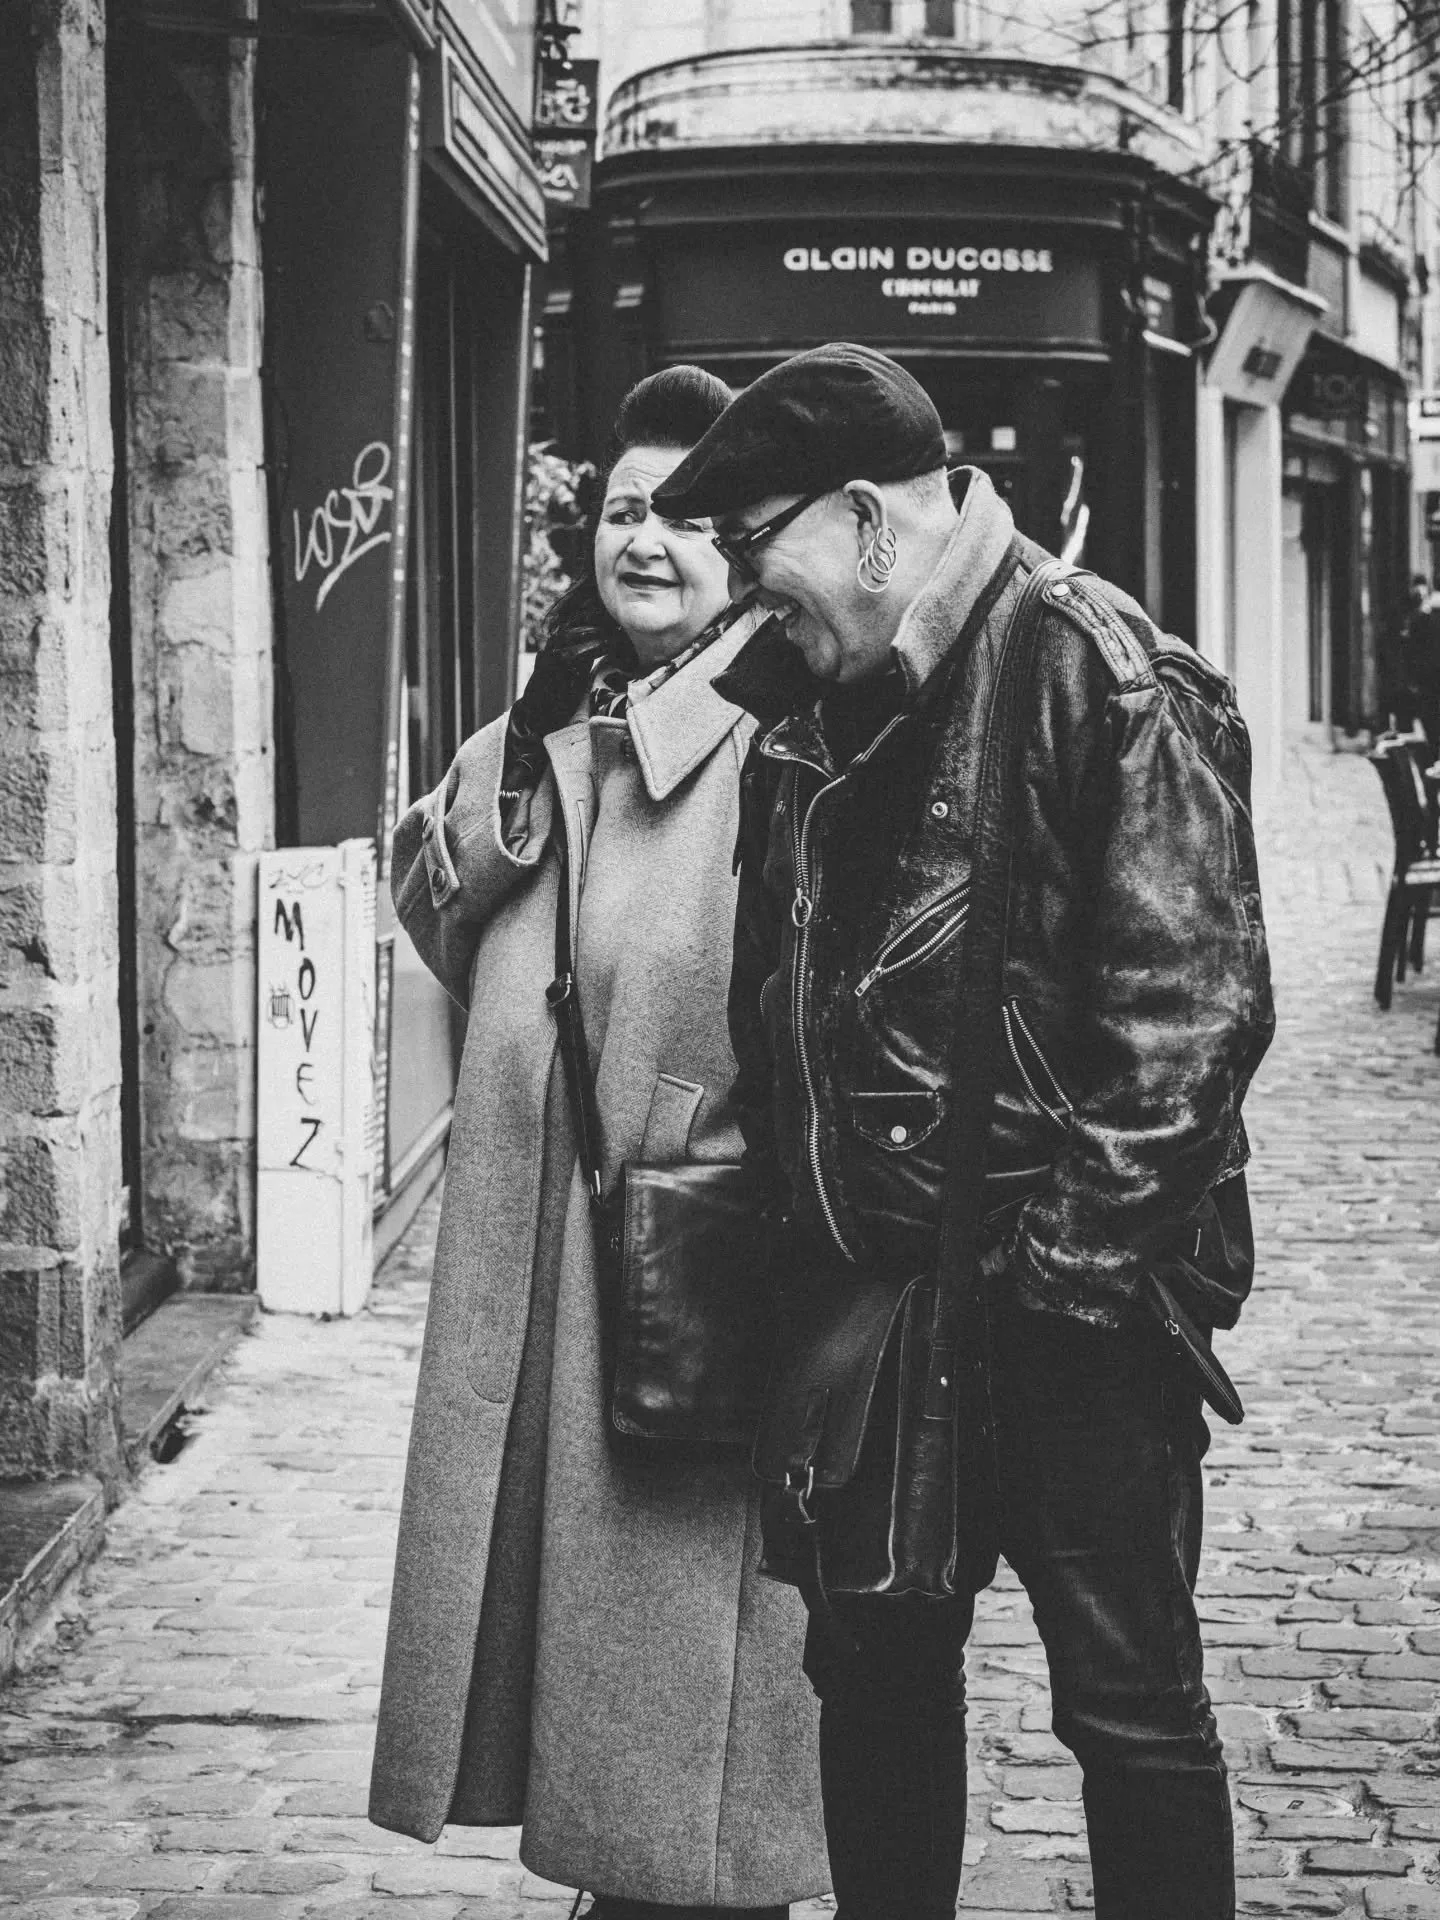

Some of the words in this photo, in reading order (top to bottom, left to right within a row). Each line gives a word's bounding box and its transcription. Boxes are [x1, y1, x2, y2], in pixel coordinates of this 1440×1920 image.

[783, 246, 895, 272] ALAIN
[906, 246, 1053, 273] DUCASSE
[273, 898, 322, 1166] MOVEZ
